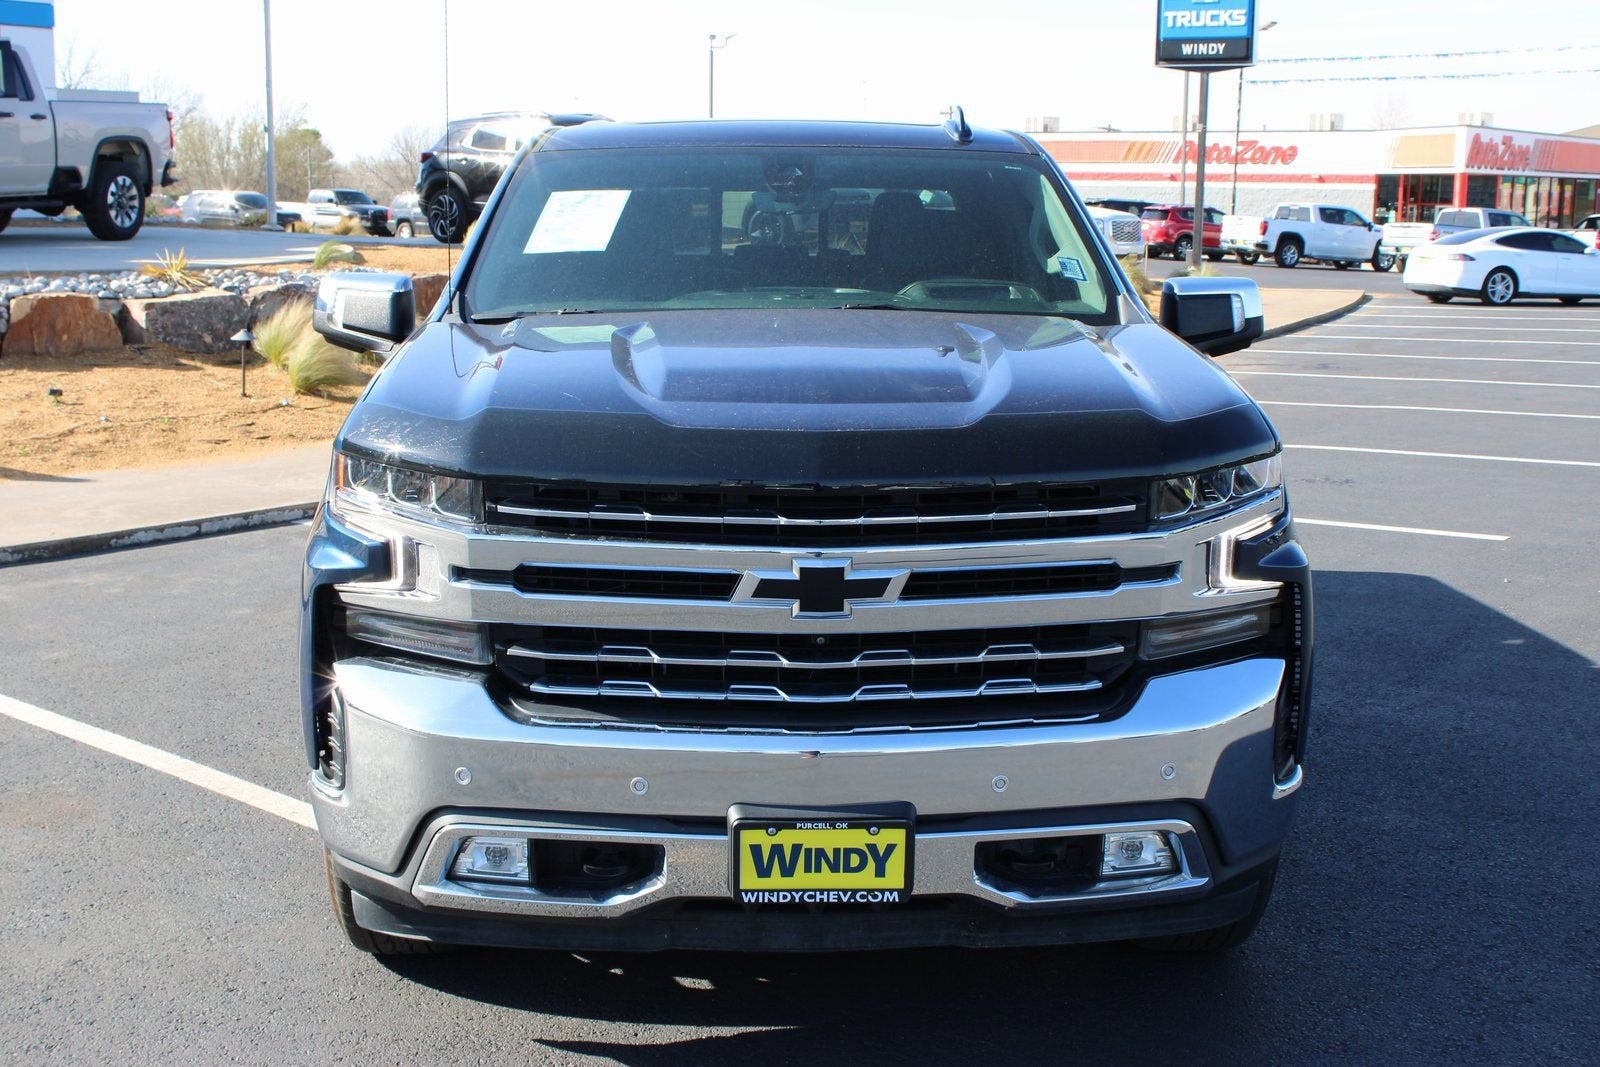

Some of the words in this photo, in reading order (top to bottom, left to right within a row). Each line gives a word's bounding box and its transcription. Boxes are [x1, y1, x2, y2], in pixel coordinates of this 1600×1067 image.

[1164, 9, 1247, 28] TRUCKS
[1181, 42, 1226, 55] WINDY
[796, 822, 833, 830] PURCELL,
[748, 843, 898, 878] WINDY
[741, 890, 899, 903] WINDYCHEV.COM
